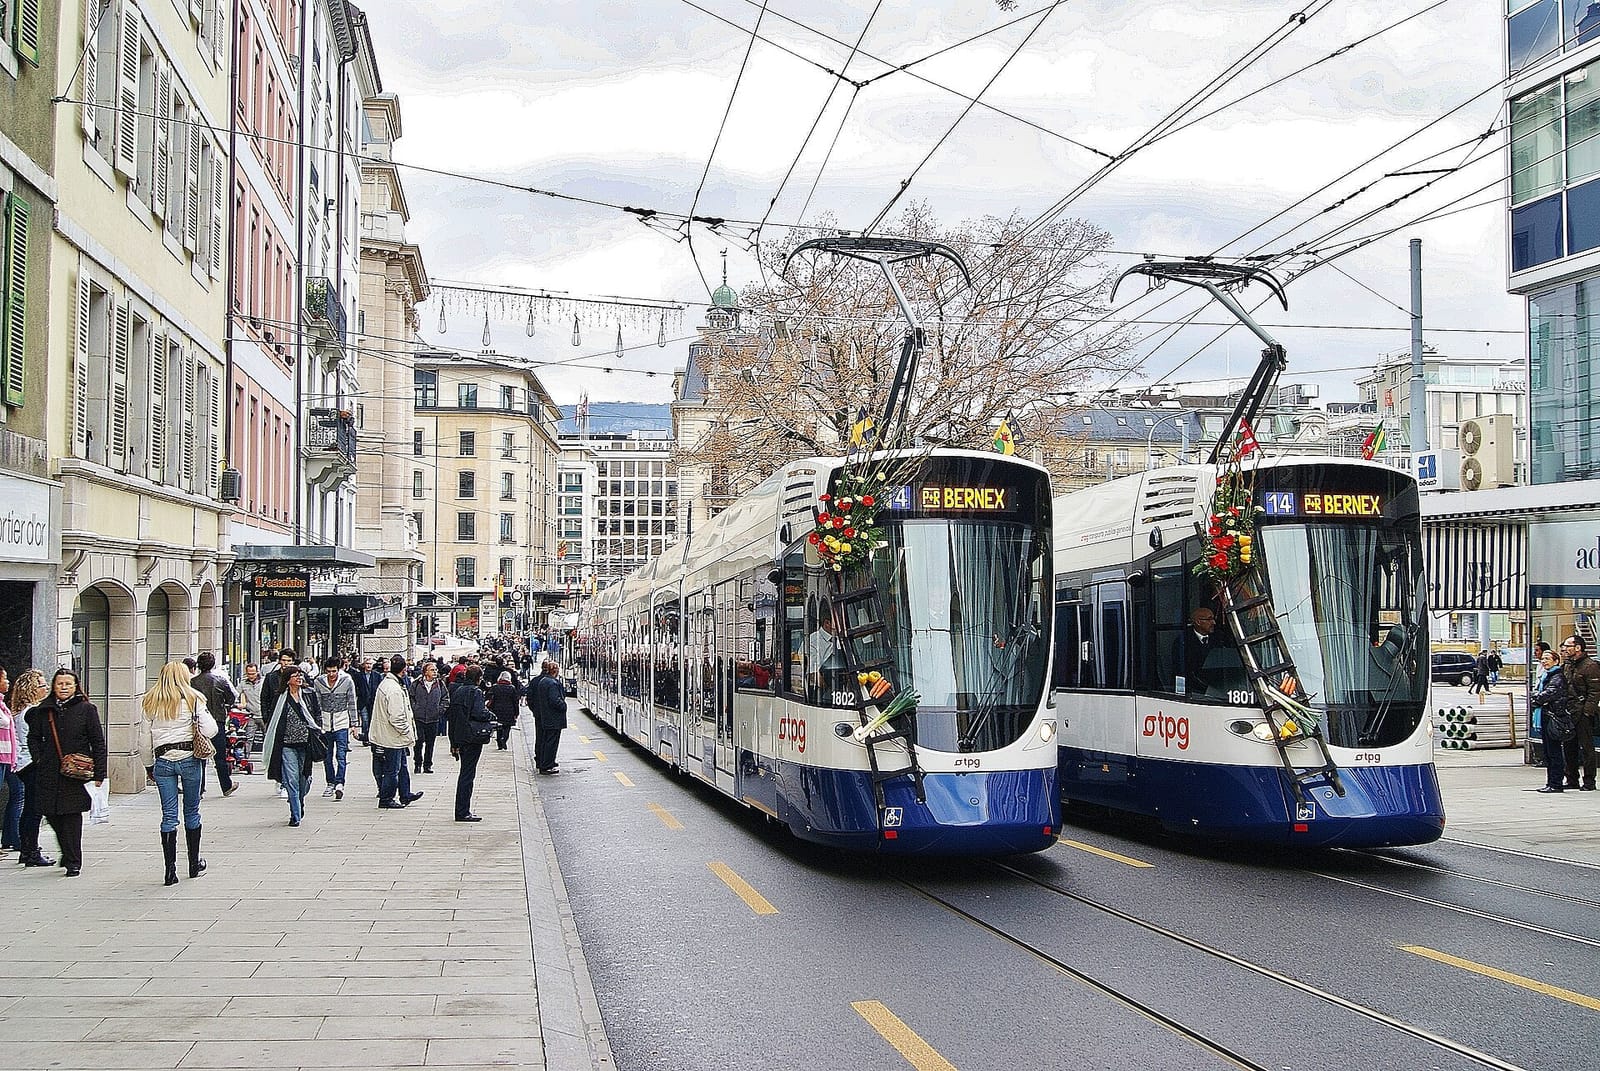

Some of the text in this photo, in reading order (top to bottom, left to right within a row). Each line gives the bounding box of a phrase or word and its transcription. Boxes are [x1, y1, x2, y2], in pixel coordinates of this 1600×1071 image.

[885, 487, 1005, 509] 4 P+R BERNEX
[1268, 494, 1381, 515] 14 P+R BERNEX
[255, 576, 306, 588] L'escalade
[831, 691, 855, 706] 1802
[1227, 690, 1255, 704] 1801
